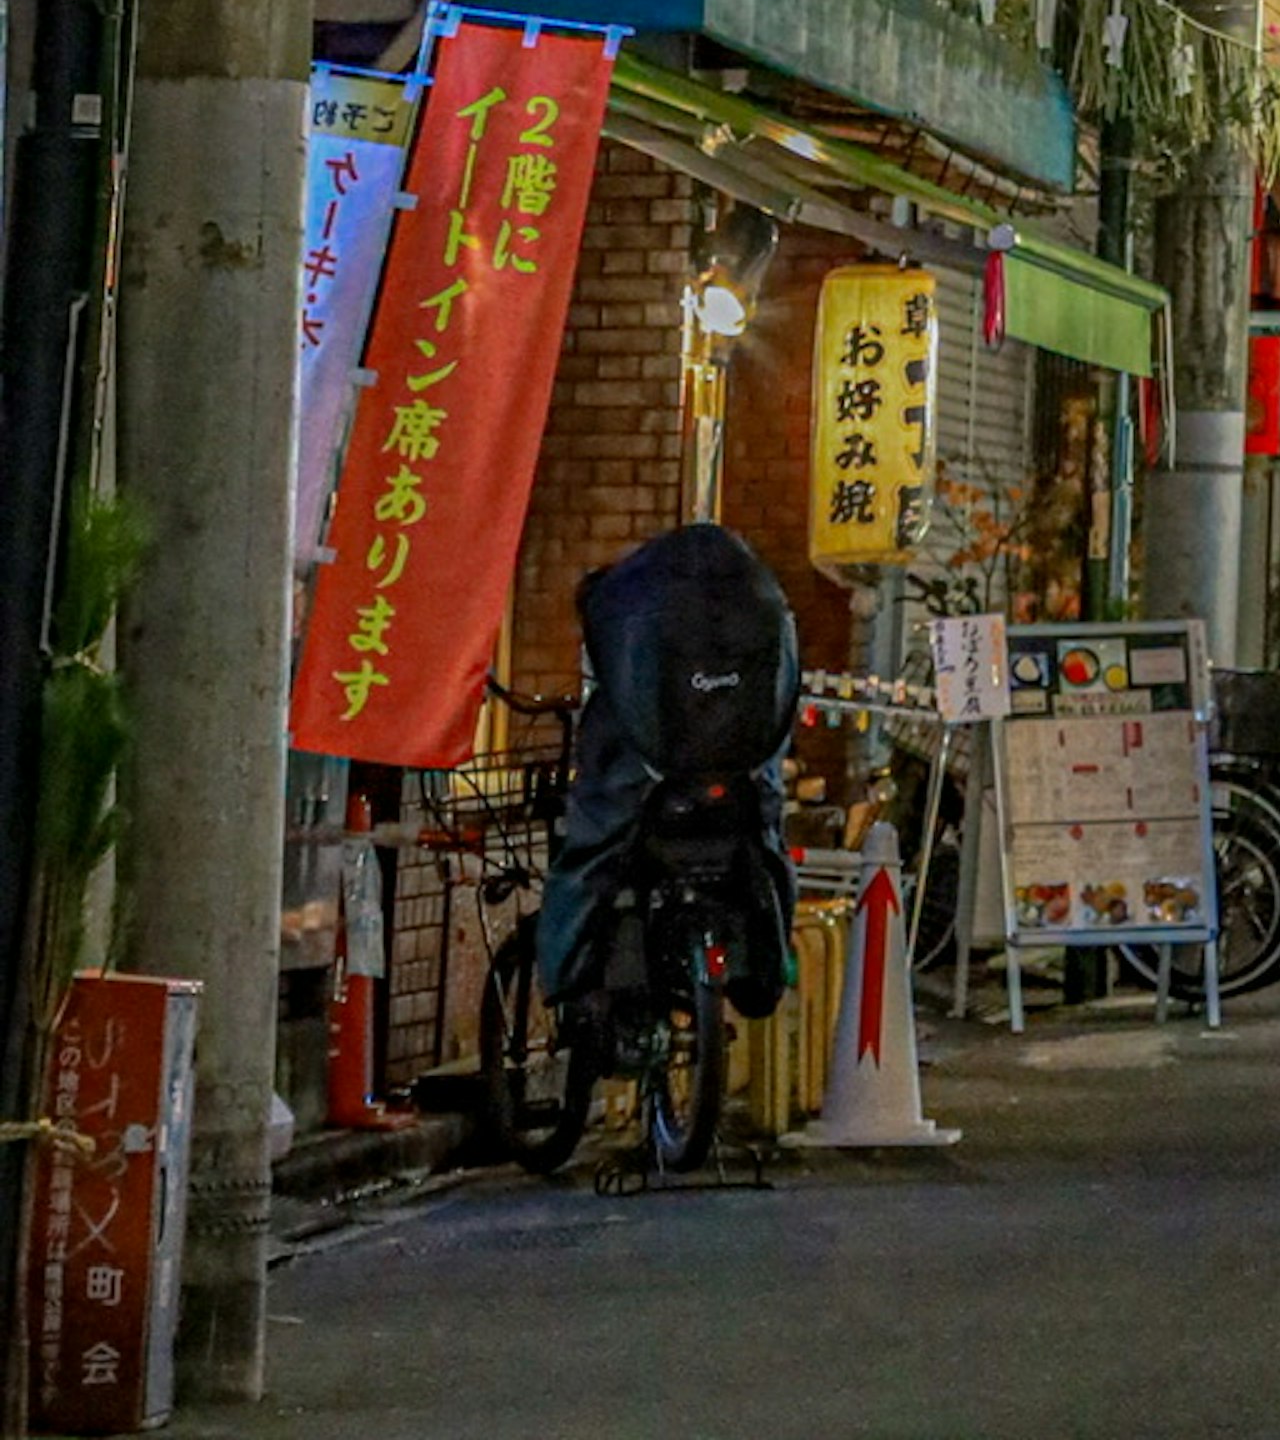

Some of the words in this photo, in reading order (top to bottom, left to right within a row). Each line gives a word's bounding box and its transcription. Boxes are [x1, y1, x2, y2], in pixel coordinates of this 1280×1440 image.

[493, 94, 560, 276] 2階に
[331, 86, 507, 723] イートイン席あります
[829, 326, 885, 524] お好み焼
